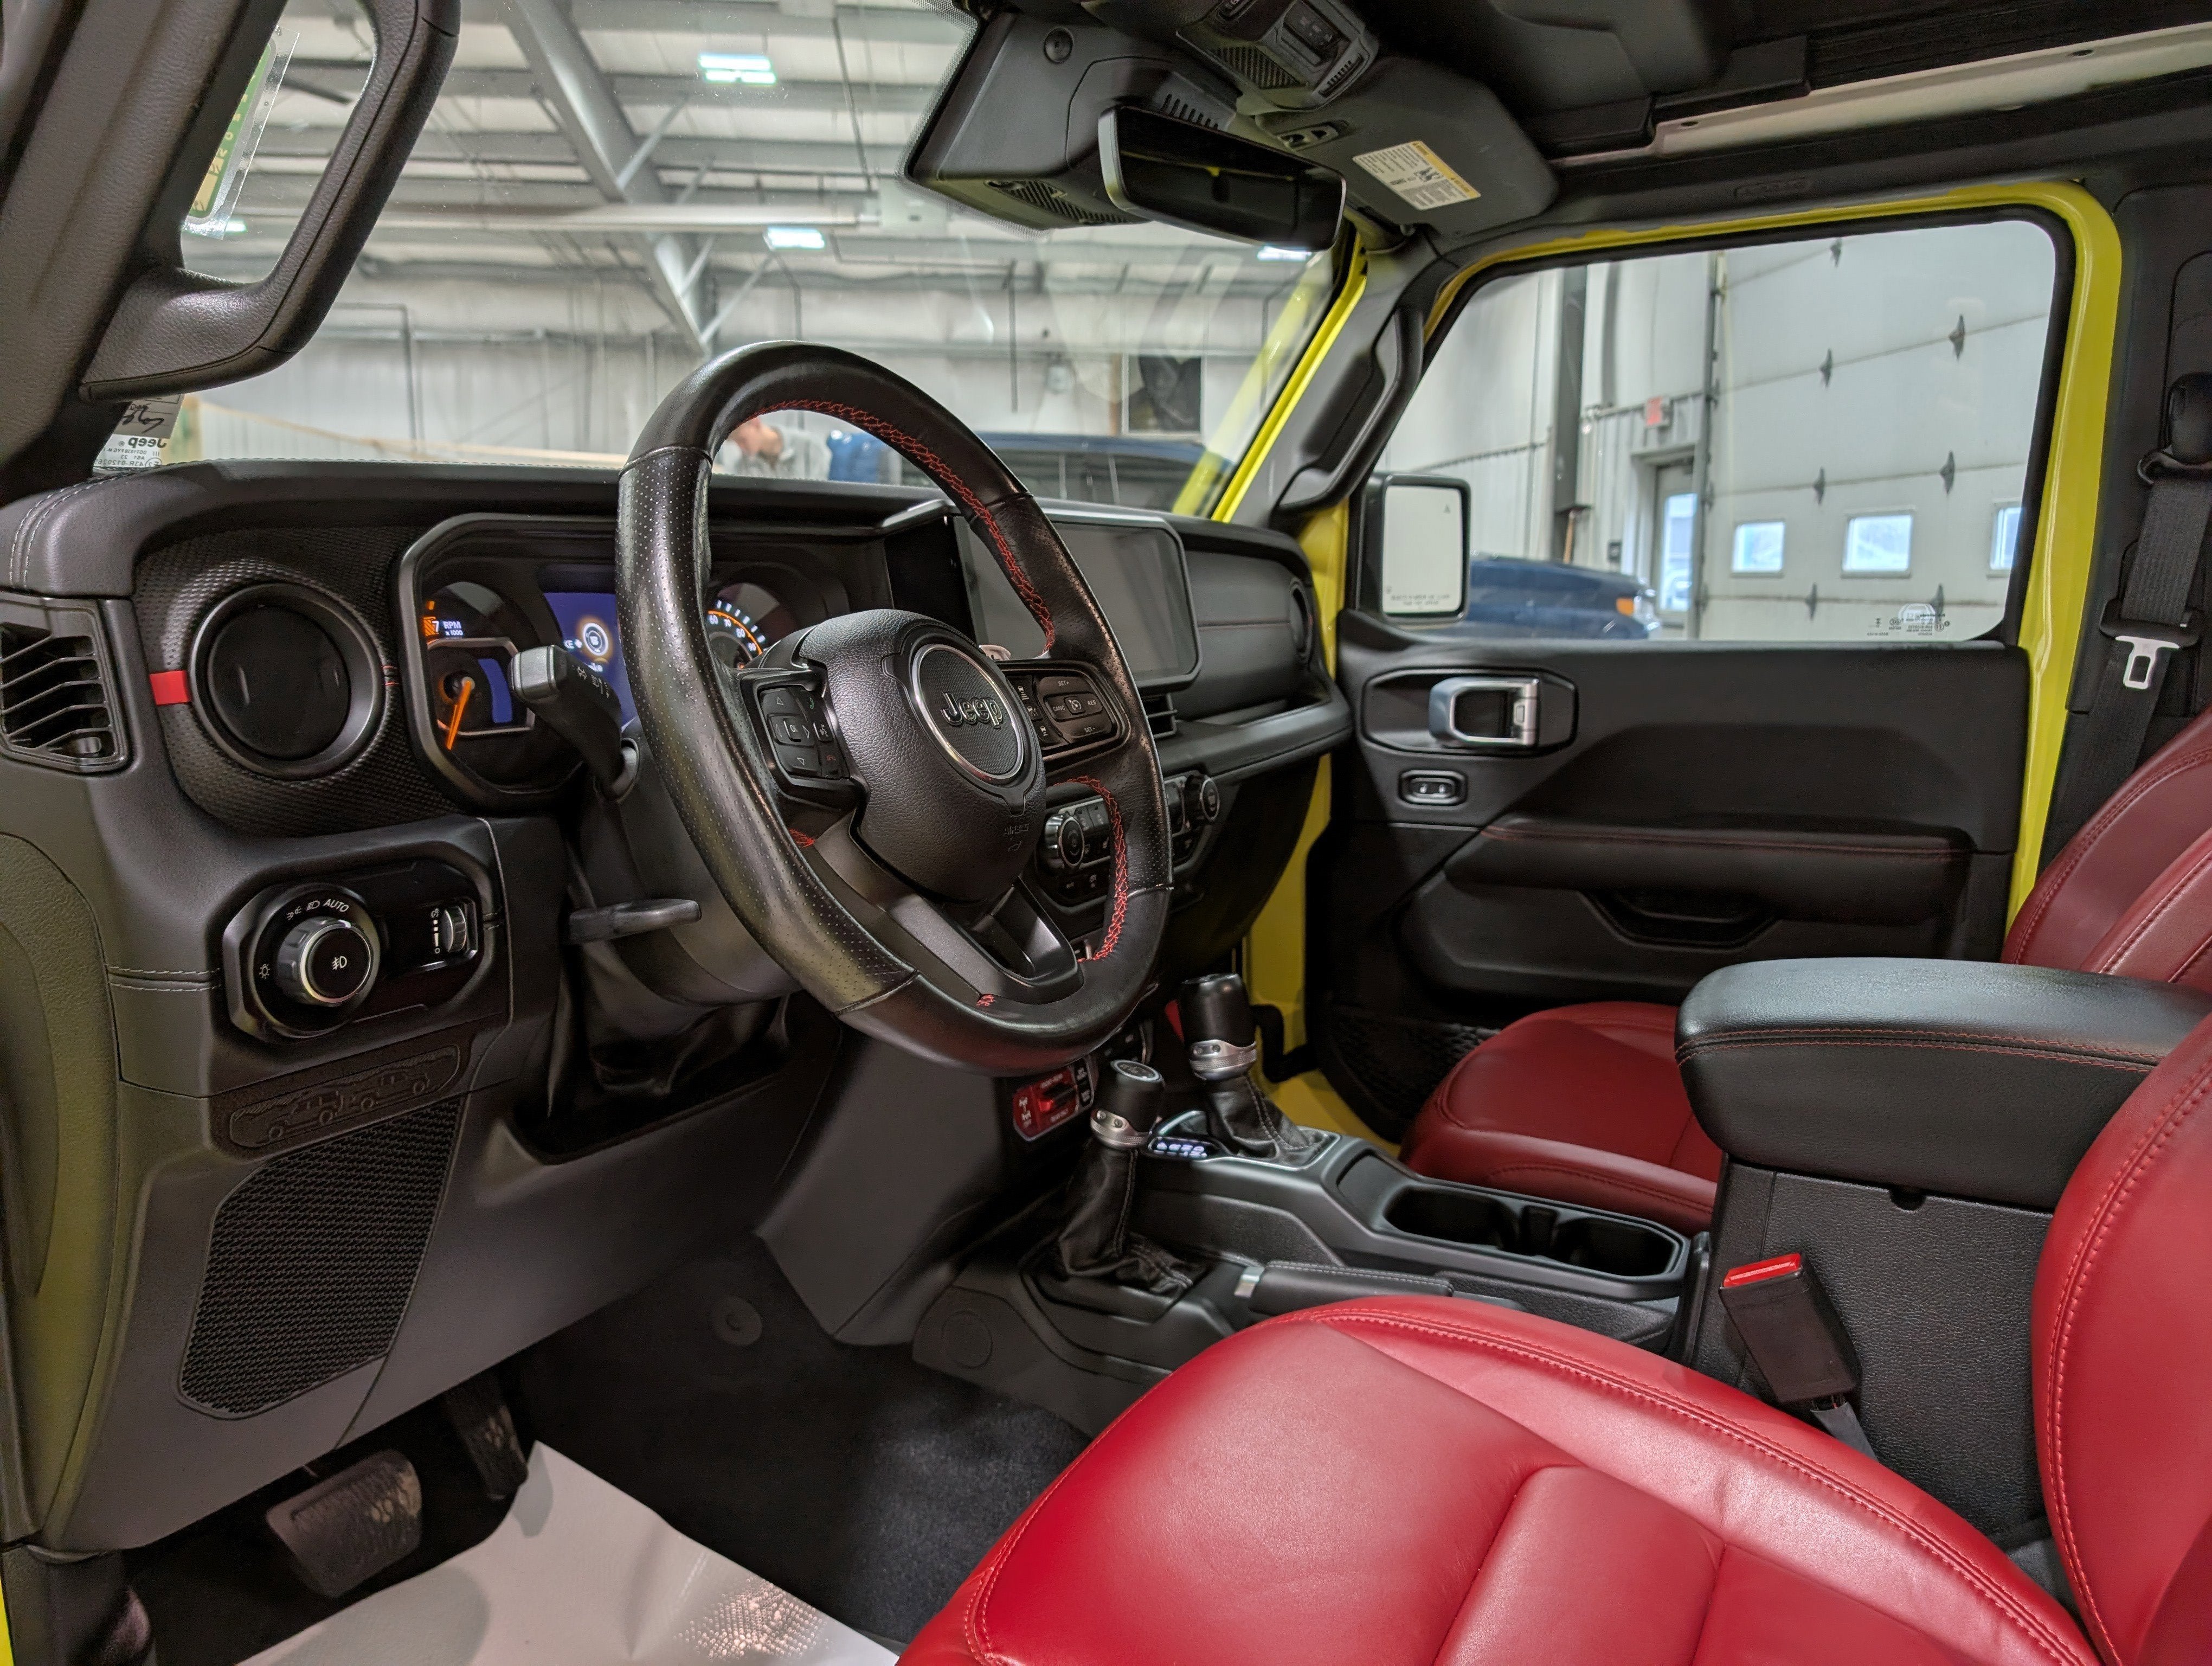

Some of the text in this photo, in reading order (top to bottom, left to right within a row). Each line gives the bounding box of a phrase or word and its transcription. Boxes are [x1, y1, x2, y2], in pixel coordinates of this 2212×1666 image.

[709, 614, 718, 624] 60
[432, 620, 440, 632] 7
[443, 620, 461, 629] RPM
[736, 628, 745, 638] 80
[747, 642, 756, 651] 90
[940, 692, 1003, 728] Jeep
[323, 899, 350, 913] AUTO
